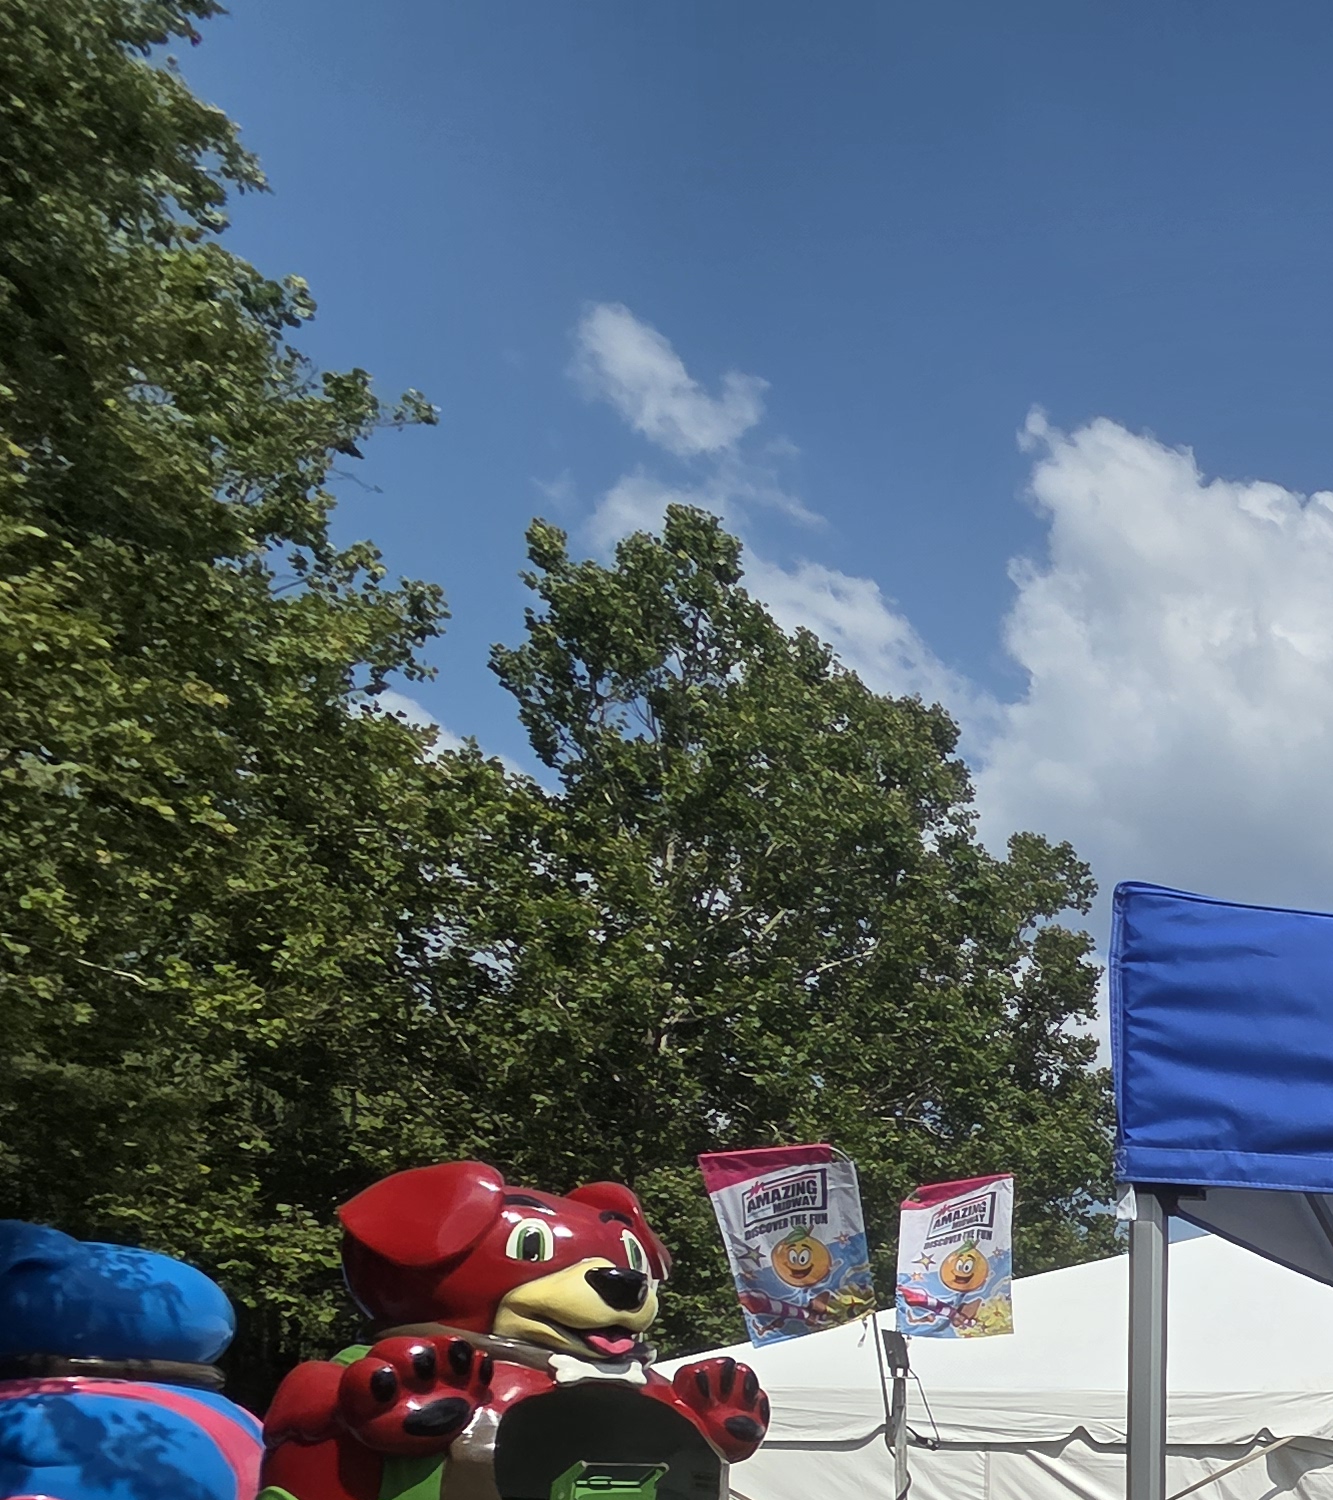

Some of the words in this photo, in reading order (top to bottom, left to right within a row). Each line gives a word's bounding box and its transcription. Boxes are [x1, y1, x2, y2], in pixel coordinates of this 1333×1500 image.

[747, 1179, 819, 1213] AMAZING
[773, 1195, 818, 1215] MIDWAY
[745, 1218, 790, 1240] DISCOVER
[808, 1211, 829, 1226] FUN
[932, 1201, 987, 1229] AMAZING
[923, 1234, 963, 1250] DISCOVER
[976, 1229, 993, 1241] FUN
